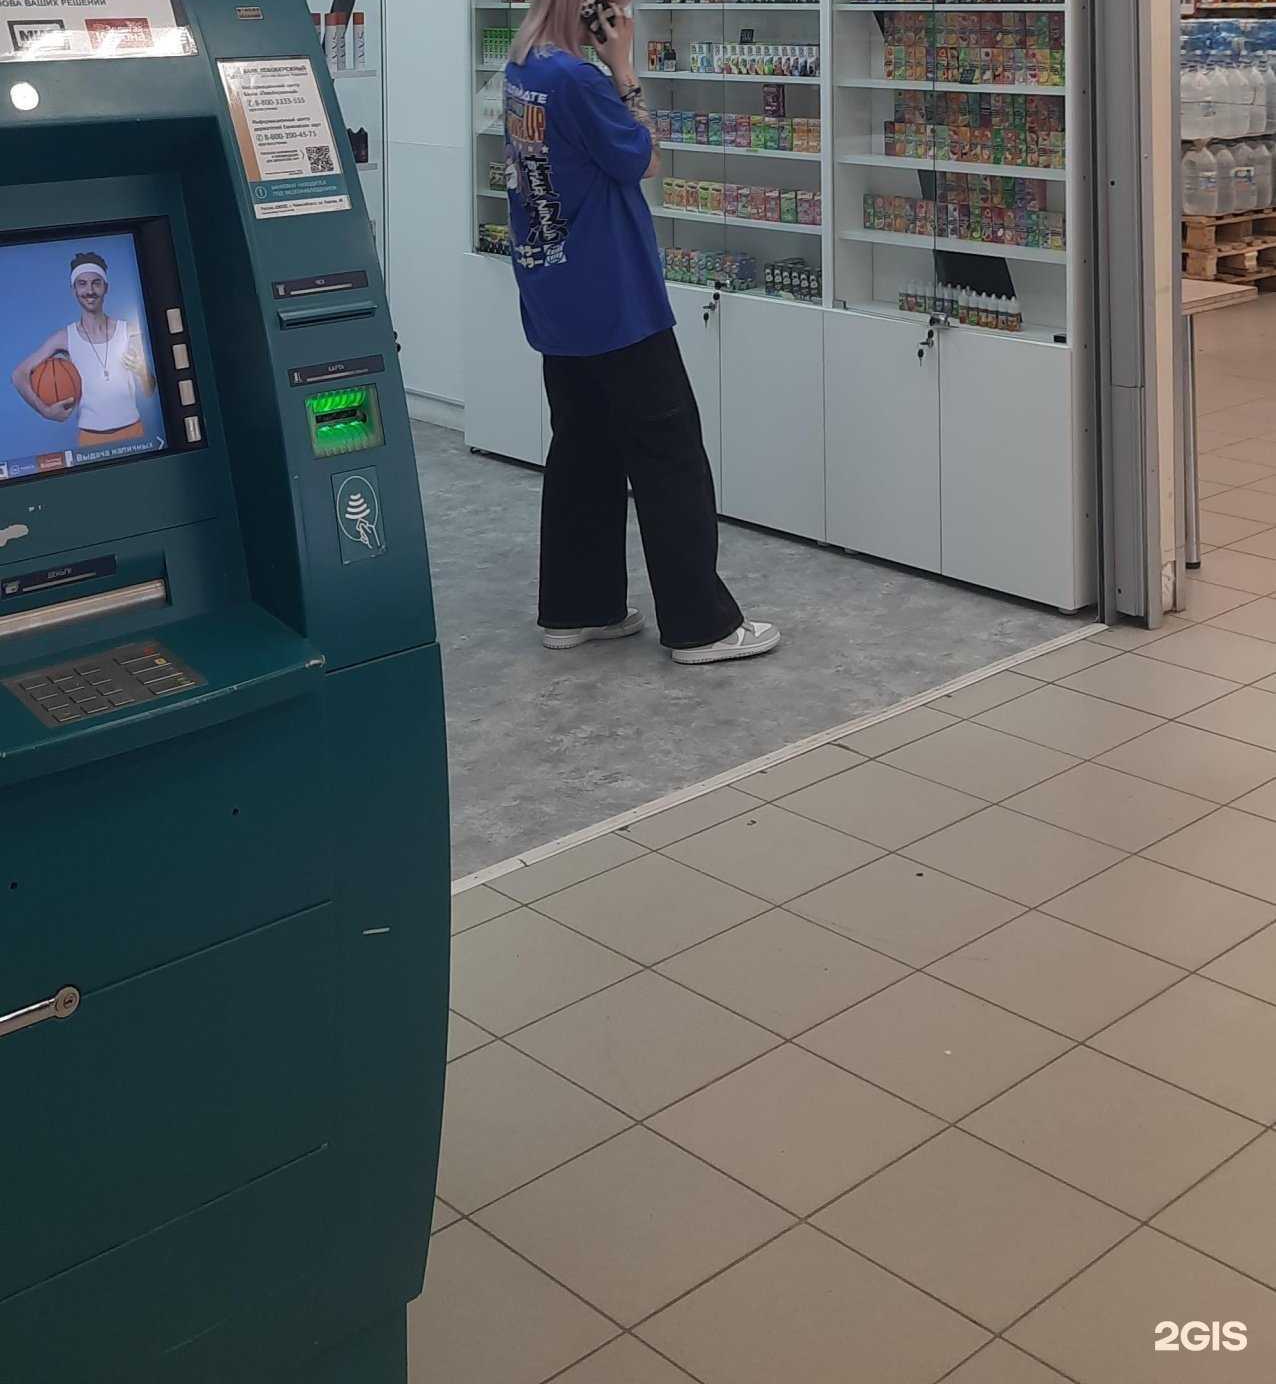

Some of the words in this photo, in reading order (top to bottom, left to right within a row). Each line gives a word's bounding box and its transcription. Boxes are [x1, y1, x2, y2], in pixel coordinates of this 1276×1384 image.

[24, 0, 58, 7] ВАШИХ
[76, 450, 110, 463] Выдача
[111, 442, 153, 456] наличных
